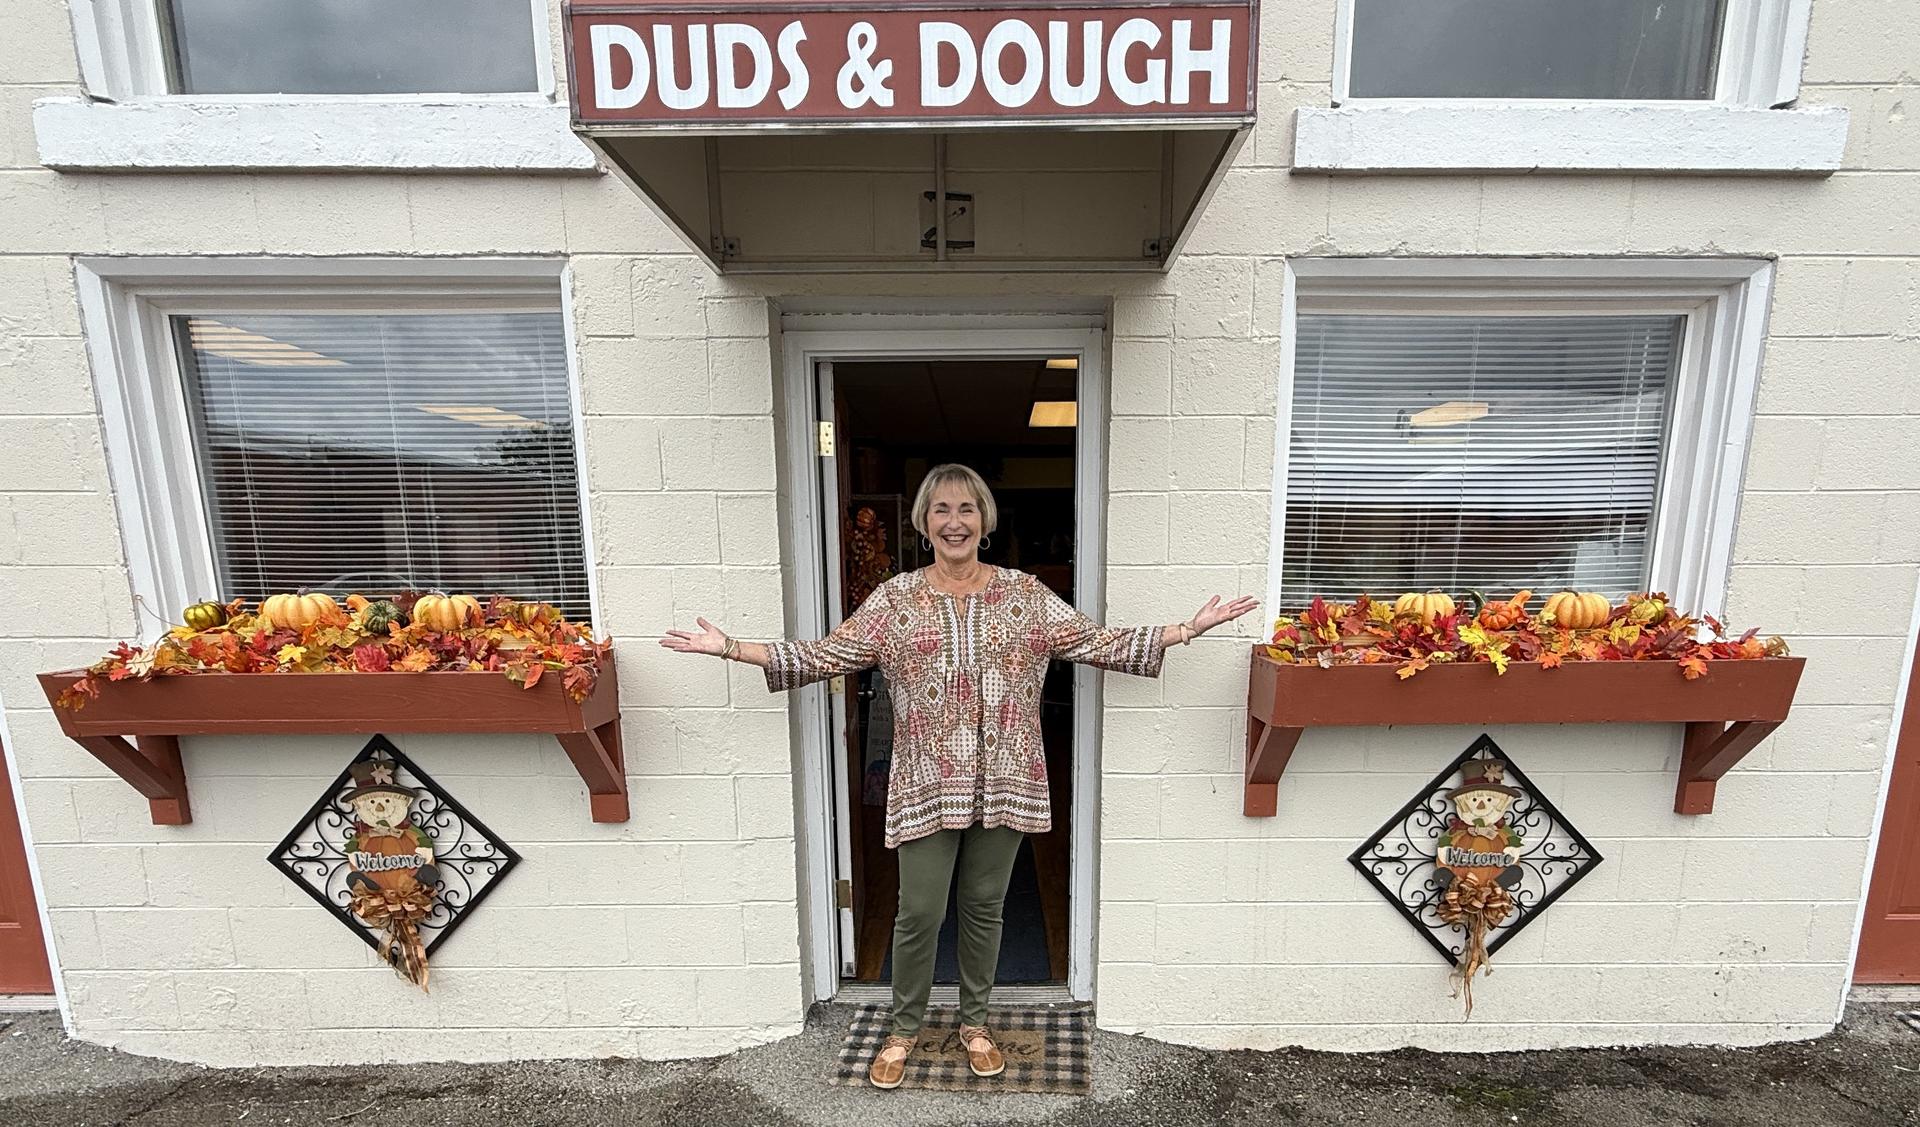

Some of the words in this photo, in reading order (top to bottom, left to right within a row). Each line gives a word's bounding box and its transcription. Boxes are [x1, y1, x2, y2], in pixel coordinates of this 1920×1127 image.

[588, 20, 809, 111] DUDS
[836, 21, 895, 110] &
[918, 17, 1231, 108] DOUGH
[354, 851, 425, 871] Welcome
[1446, 847, 1515, 867] Welcome
